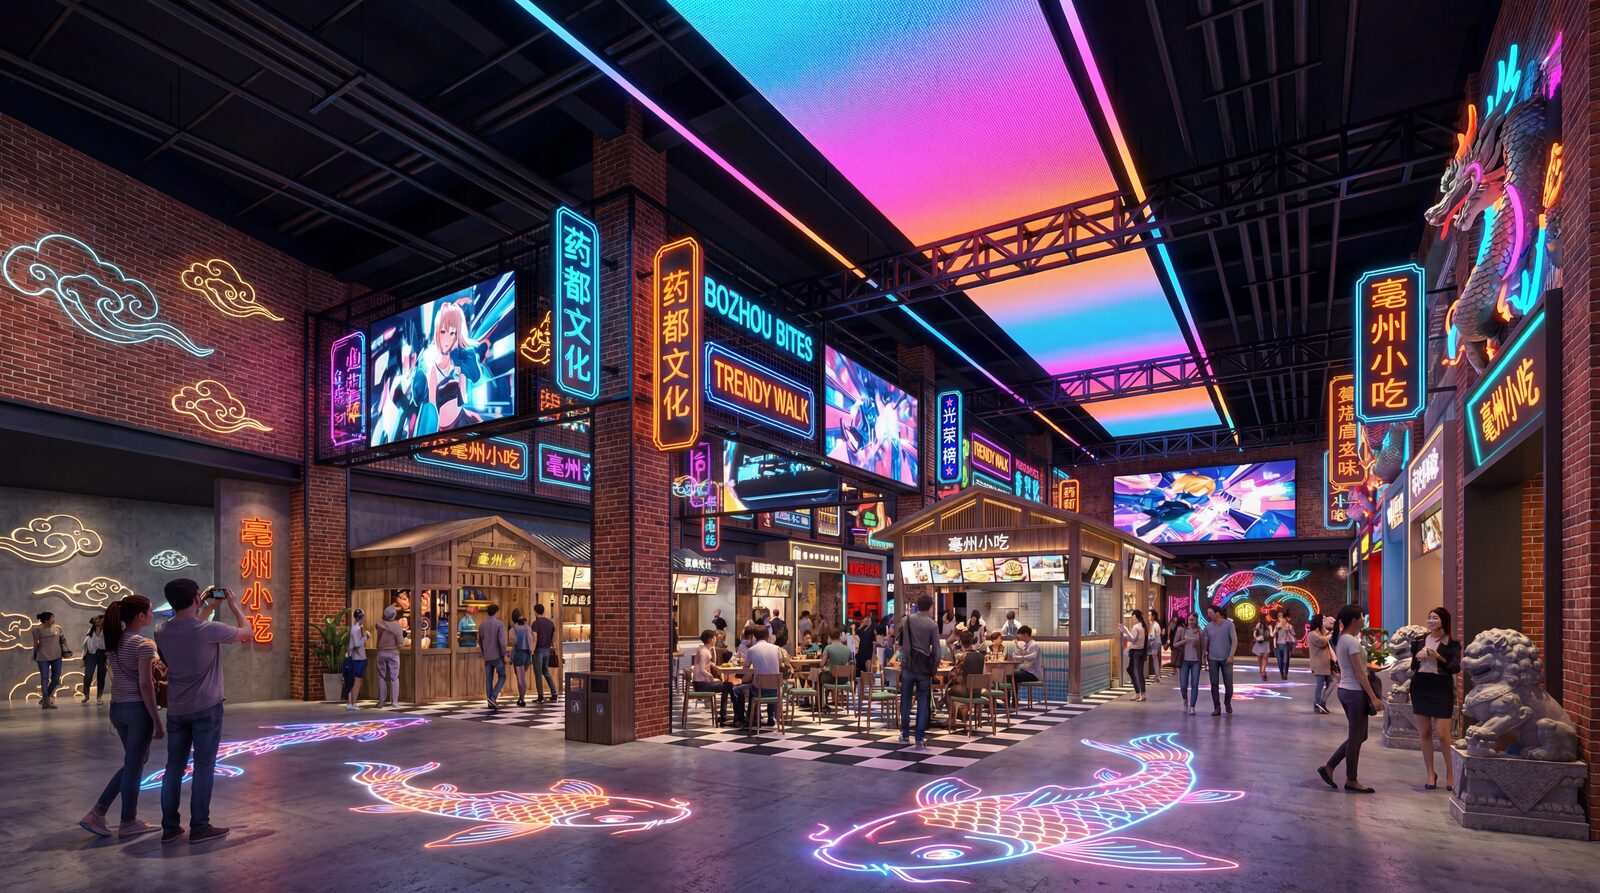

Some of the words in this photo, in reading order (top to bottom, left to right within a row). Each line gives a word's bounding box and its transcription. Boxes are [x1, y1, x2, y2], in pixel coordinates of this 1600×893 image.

[563, 224, 592, 383] 药都文化
[662, 268, 691, 421] 药都文化
[704, 276, 772, 340] BOZHOU
[775, 318, 813, 363] BITES
[713, 359, 772, 409] TRENDY
[772, 384, 810, 425] WALK
[942, 406, 957, 465] 光荣榜
